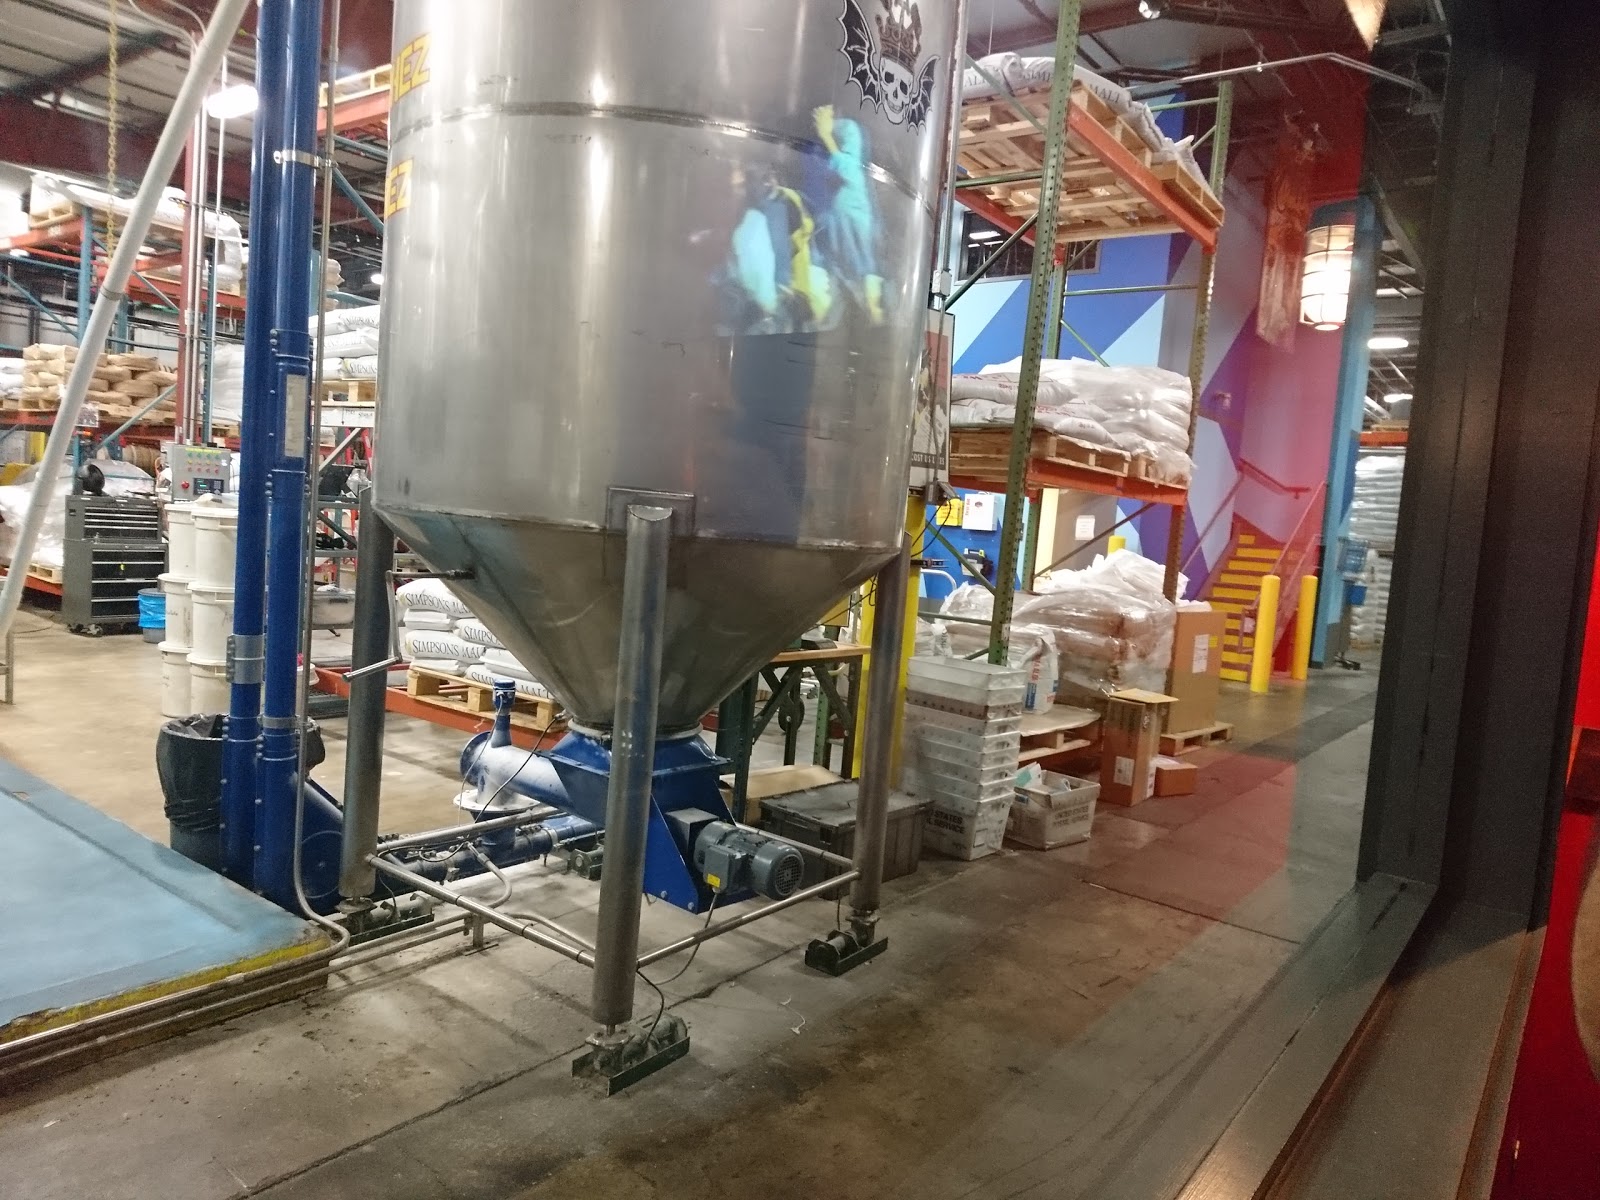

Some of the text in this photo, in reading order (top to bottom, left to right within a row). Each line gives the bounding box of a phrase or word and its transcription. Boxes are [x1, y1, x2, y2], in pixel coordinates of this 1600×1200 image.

[384, 158, 414, 219] EZ
[405, 592, 450, 613] SIMPSONS
[412, 639, 460, 658] SIMPSONS
